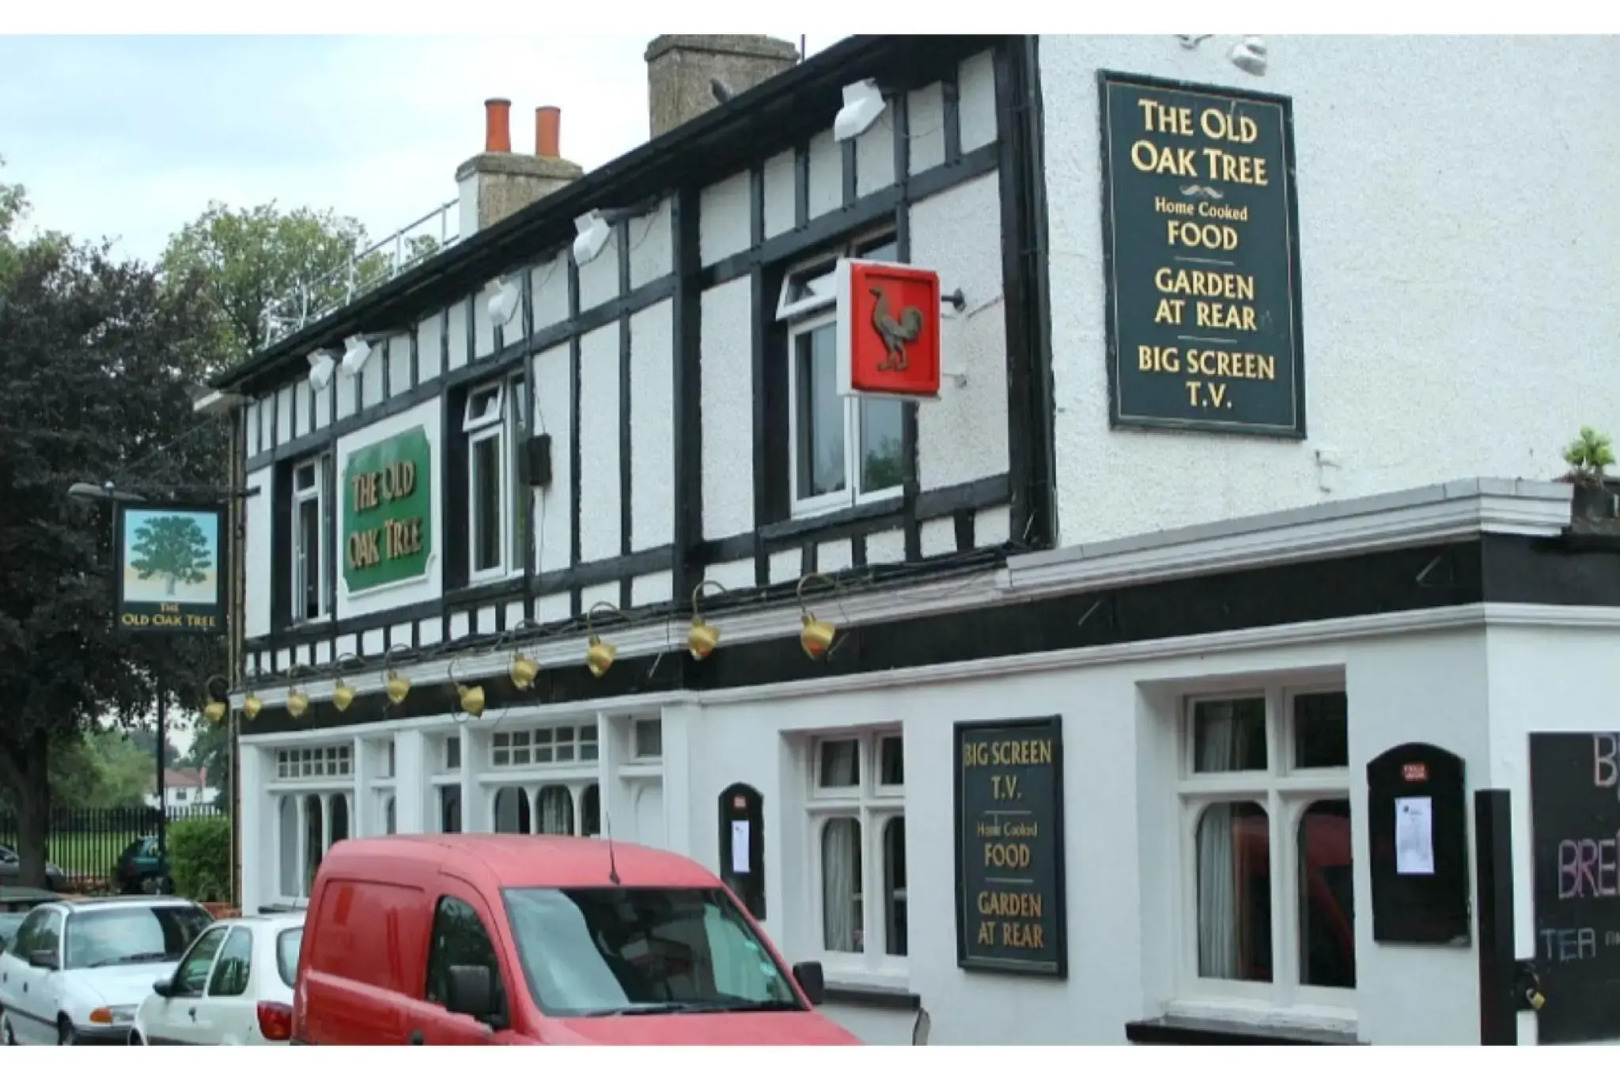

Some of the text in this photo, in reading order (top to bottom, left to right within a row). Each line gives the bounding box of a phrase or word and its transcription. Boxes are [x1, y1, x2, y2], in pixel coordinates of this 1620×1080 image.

[1138, 98, 1258, 143] THE OLD
[1131, 140, 1268, 185] OAK TREE
[1155, 197, 1248, 221] Home Cooked
[1168, 219, 1238, 250] FOOD
[1155, 267, 1254, 300] GARDEN
[1154, 299, 1257, 331] AT REAR
[1138, 345, 1275, 380] BIG SCREEN
[1186, 381, 1232, 408] T.V.
[352, 460, 415, 512] THE OLD
[347, 517, 422, 568] OAK TREE
[122, 613, 216, 627] OLD OAK TREE
[161, 602, 179, 612] THE
[964, 739, 1052, 767] BIG SCREEN
[991, 775, 1022, 799] T.V.
[985, 843, 1031, 867] FOOD
[1558, 830, 1620, 898] BRE
[977, 891, 1042, 917] GARDEN
[977, 921, 1044, 948] AT REAR
[1540, 928, 1596, 960] TEA
